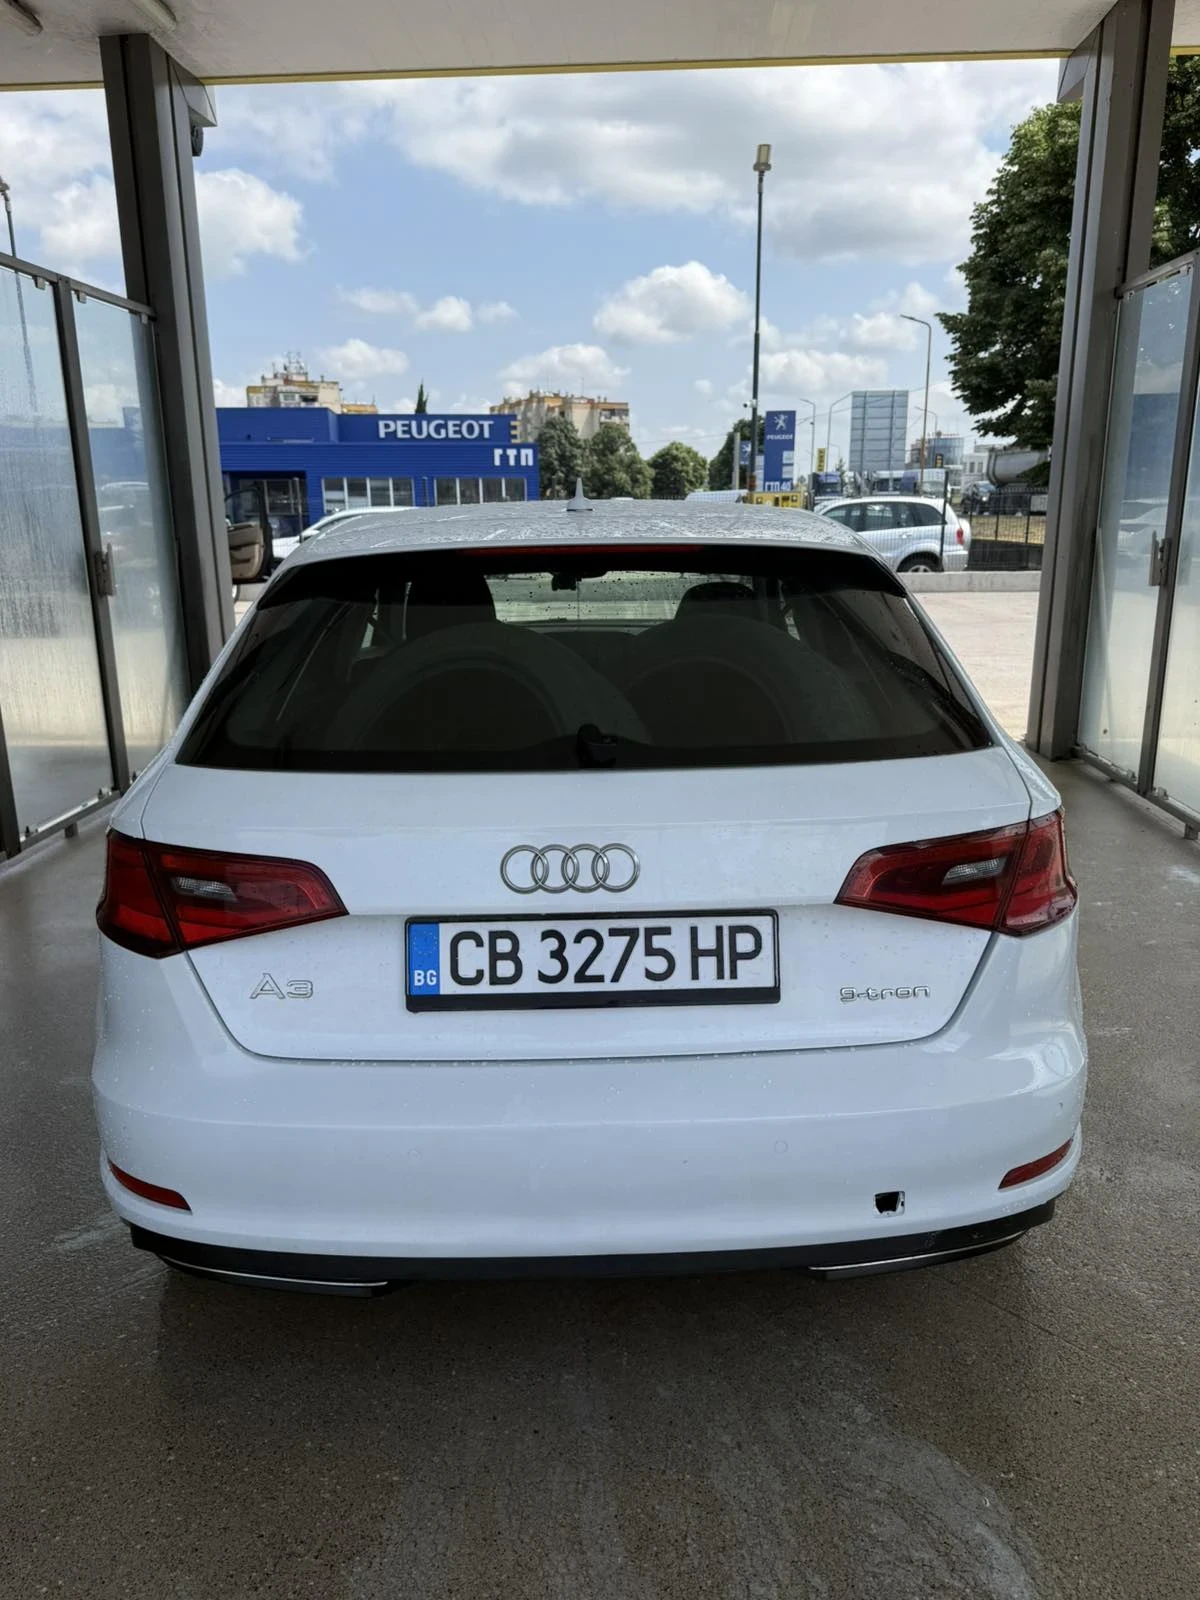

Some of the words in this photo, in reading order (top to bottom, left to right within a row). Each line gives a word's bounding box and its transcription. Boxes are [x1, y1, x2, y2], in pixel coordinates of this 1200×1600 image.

[378, 420, 495, 439] PEUGEOT
[494, 448, 534, 466] ГТП
[450, 930, 523, 986] CB
[537, 927, 676, 984] 3275
[690, 925, 762, 981] HP
[249, 972, 314, 999] A3
[414, 969, 437, 986] BG
[840, 986, 930, 1002] g-tron
